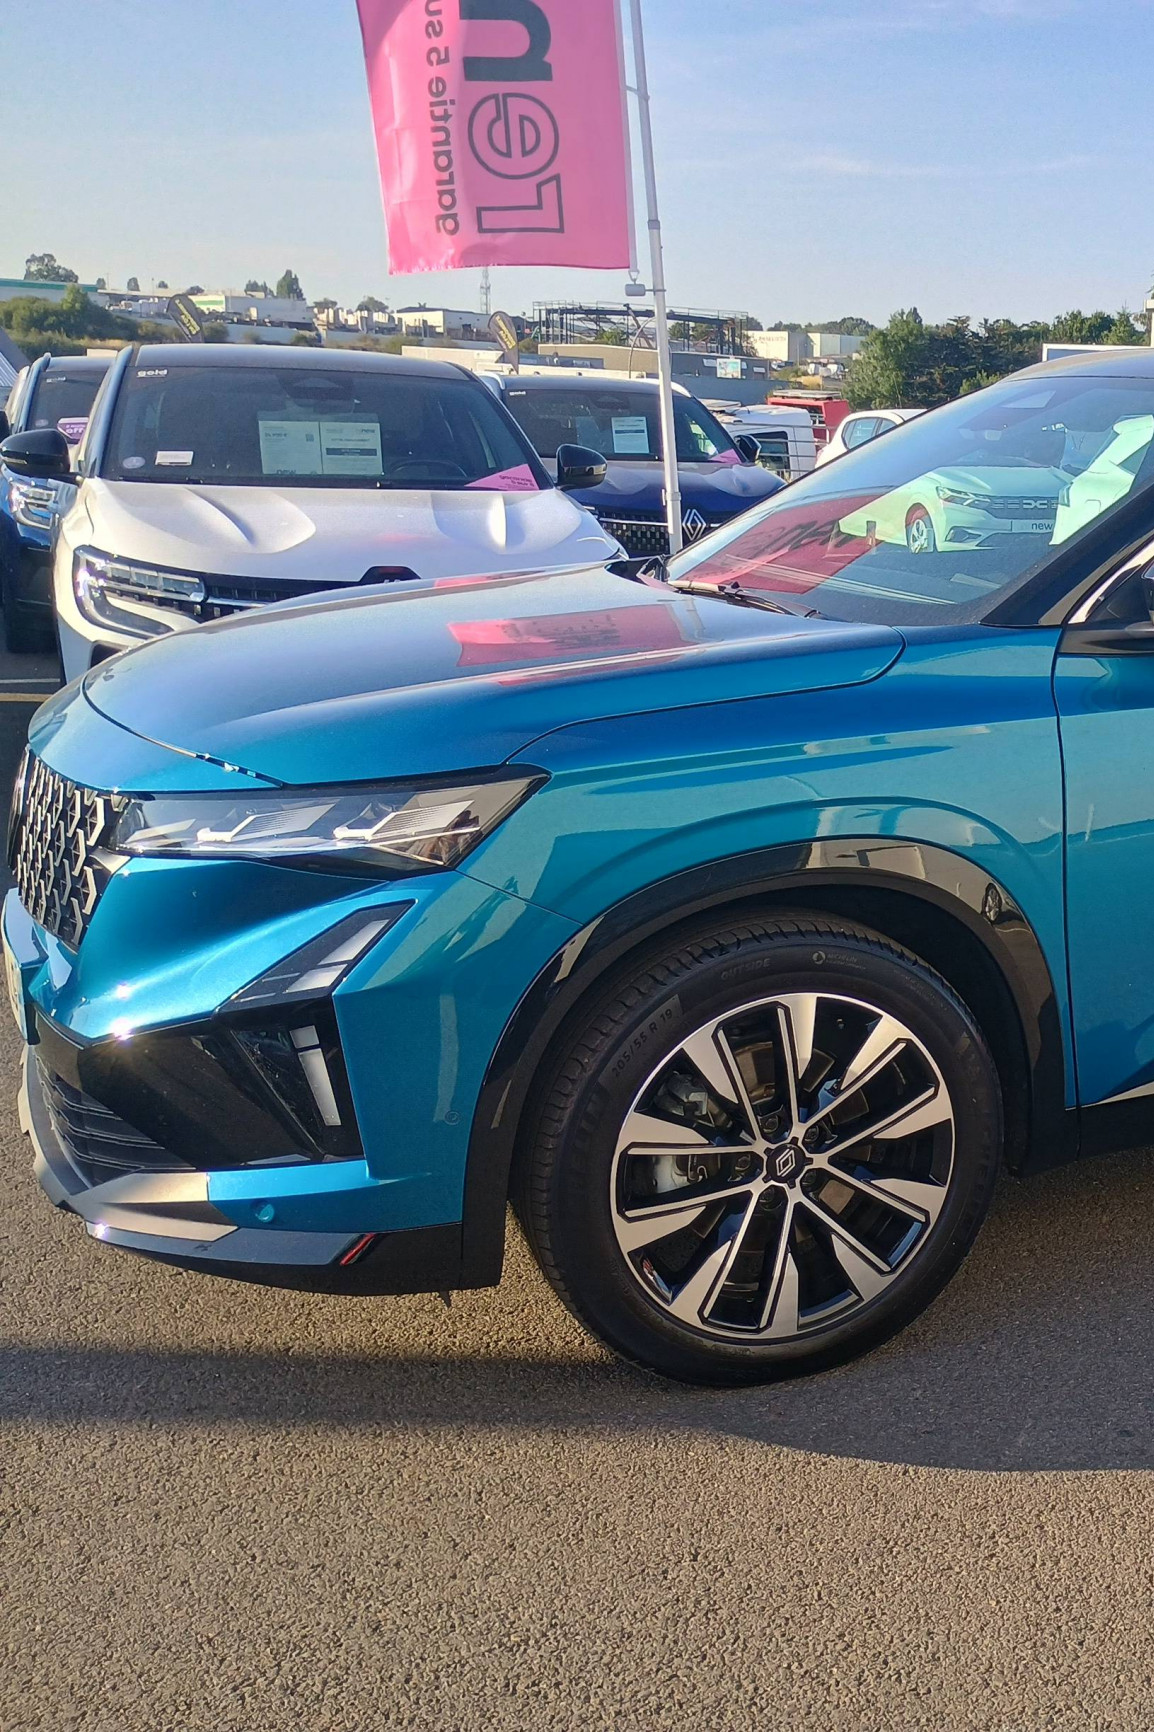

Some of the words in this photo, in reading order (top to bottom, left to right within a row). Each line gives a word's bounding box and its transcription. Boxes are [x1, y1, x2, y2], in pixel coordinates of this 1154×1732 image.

[137, 369, 168, 378] gold
[1031, 522, 1053, 531] new
[720, 957, 771, 981] OUTSIDE
[611, 1031, 648, 1077] 205/55
[648, 1021, 659, 1034] R
[660, 1008, 673, 1023] 19
